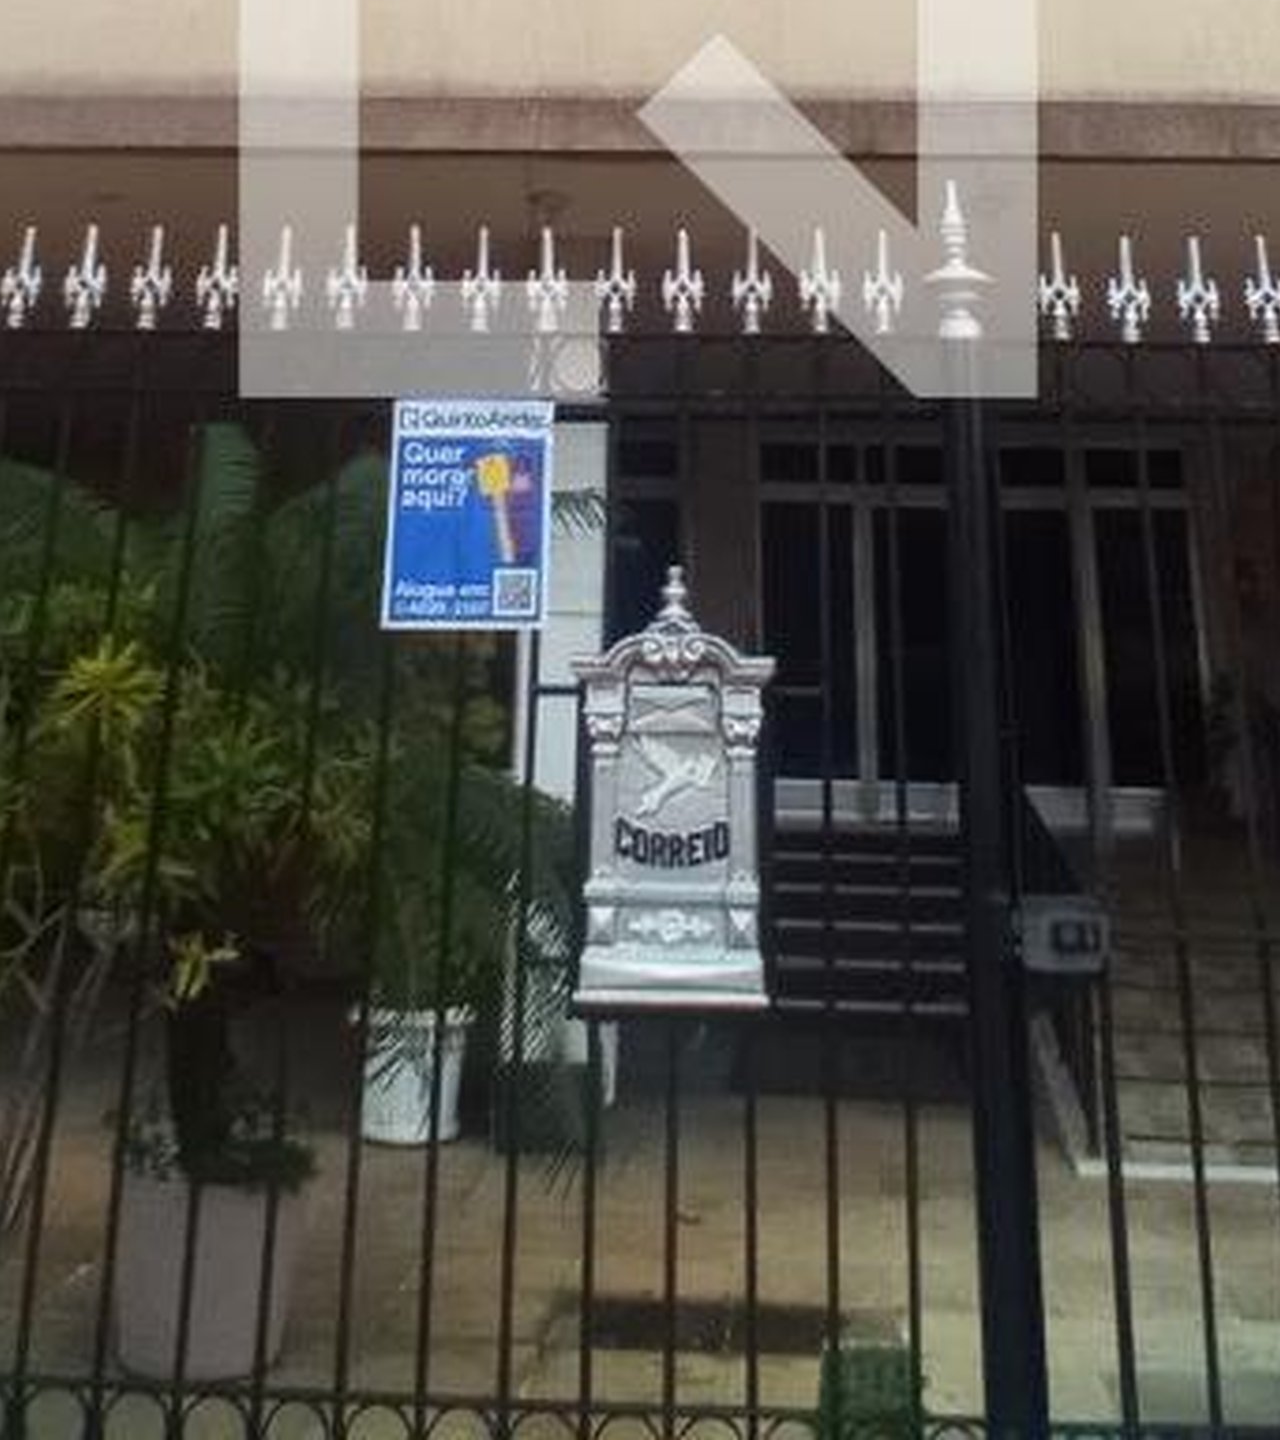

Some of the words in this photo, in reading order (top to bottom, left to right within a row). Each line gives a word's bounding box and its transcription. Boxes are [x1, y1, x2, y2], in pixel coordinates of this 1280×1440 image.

[403, 441, 465, 464] Quer
[400, 485, 468, 510] aqui?
[616, 815, 730, 869] CORREIO
